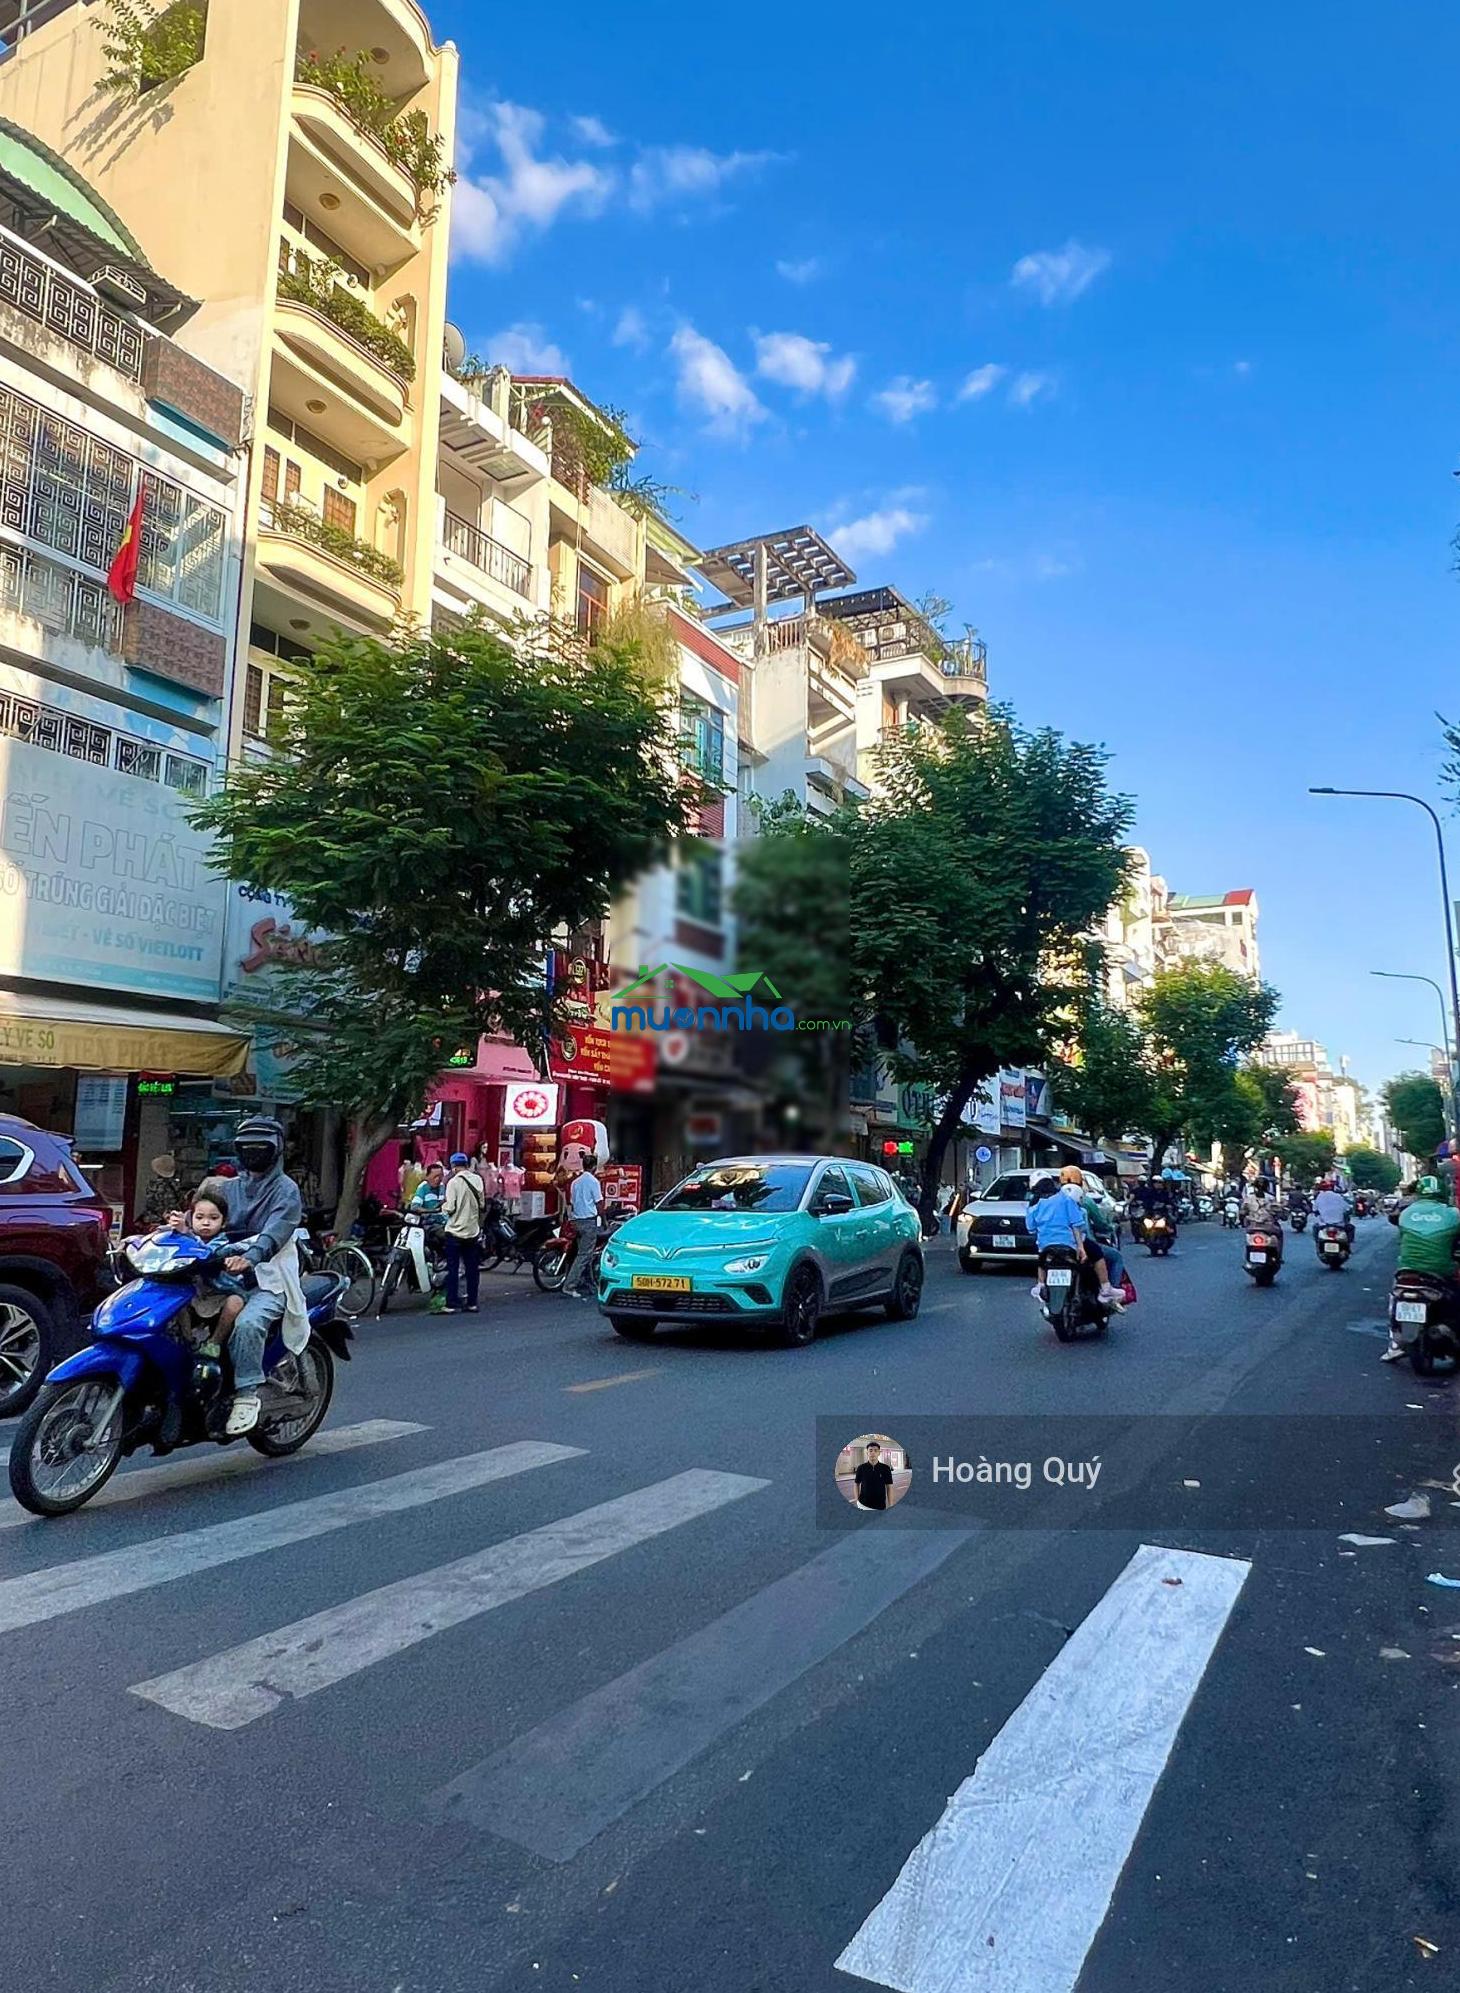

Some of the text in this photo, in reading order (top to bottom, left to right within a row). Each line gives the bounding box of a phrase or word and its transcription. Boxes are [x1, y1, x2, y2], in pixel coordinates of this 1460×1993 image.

[80, 820, 206, 892] PHÁT
[25, 869, 93, 911] TRÚNG
[96, 882, 136, 919] GIẢI
[138, 893, 177, 932] ĐẶC
[177, 902, 218, 940] BIỆT
[139, 937, 204, 962] VIETLOTT
[1411, 1211, 1442, 1222] Grab
